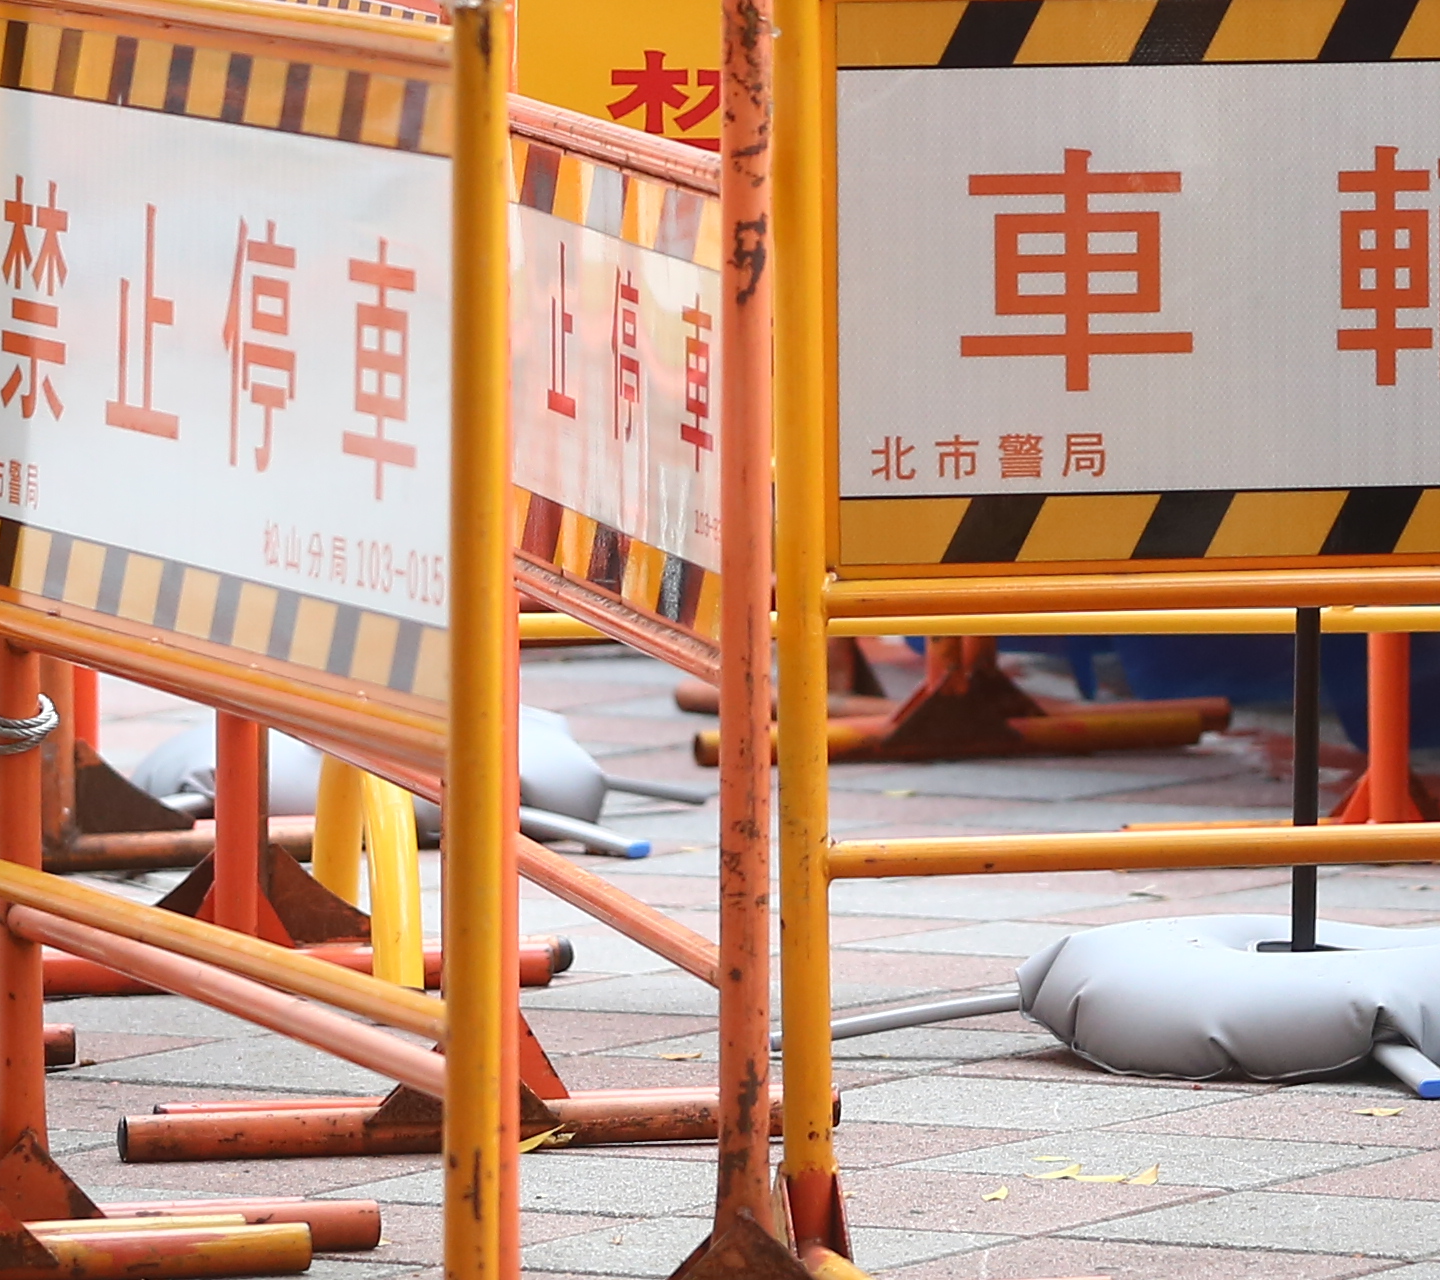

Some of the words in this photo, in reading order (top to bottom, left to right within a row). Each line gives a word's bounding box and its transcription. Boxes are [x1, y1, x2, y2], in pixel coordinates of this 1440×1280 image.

[0, 174, 417, 501] 禁止停車
[546, 241, 713, 472] 止停車
[869, 433, 1108, 483] 北市警局
